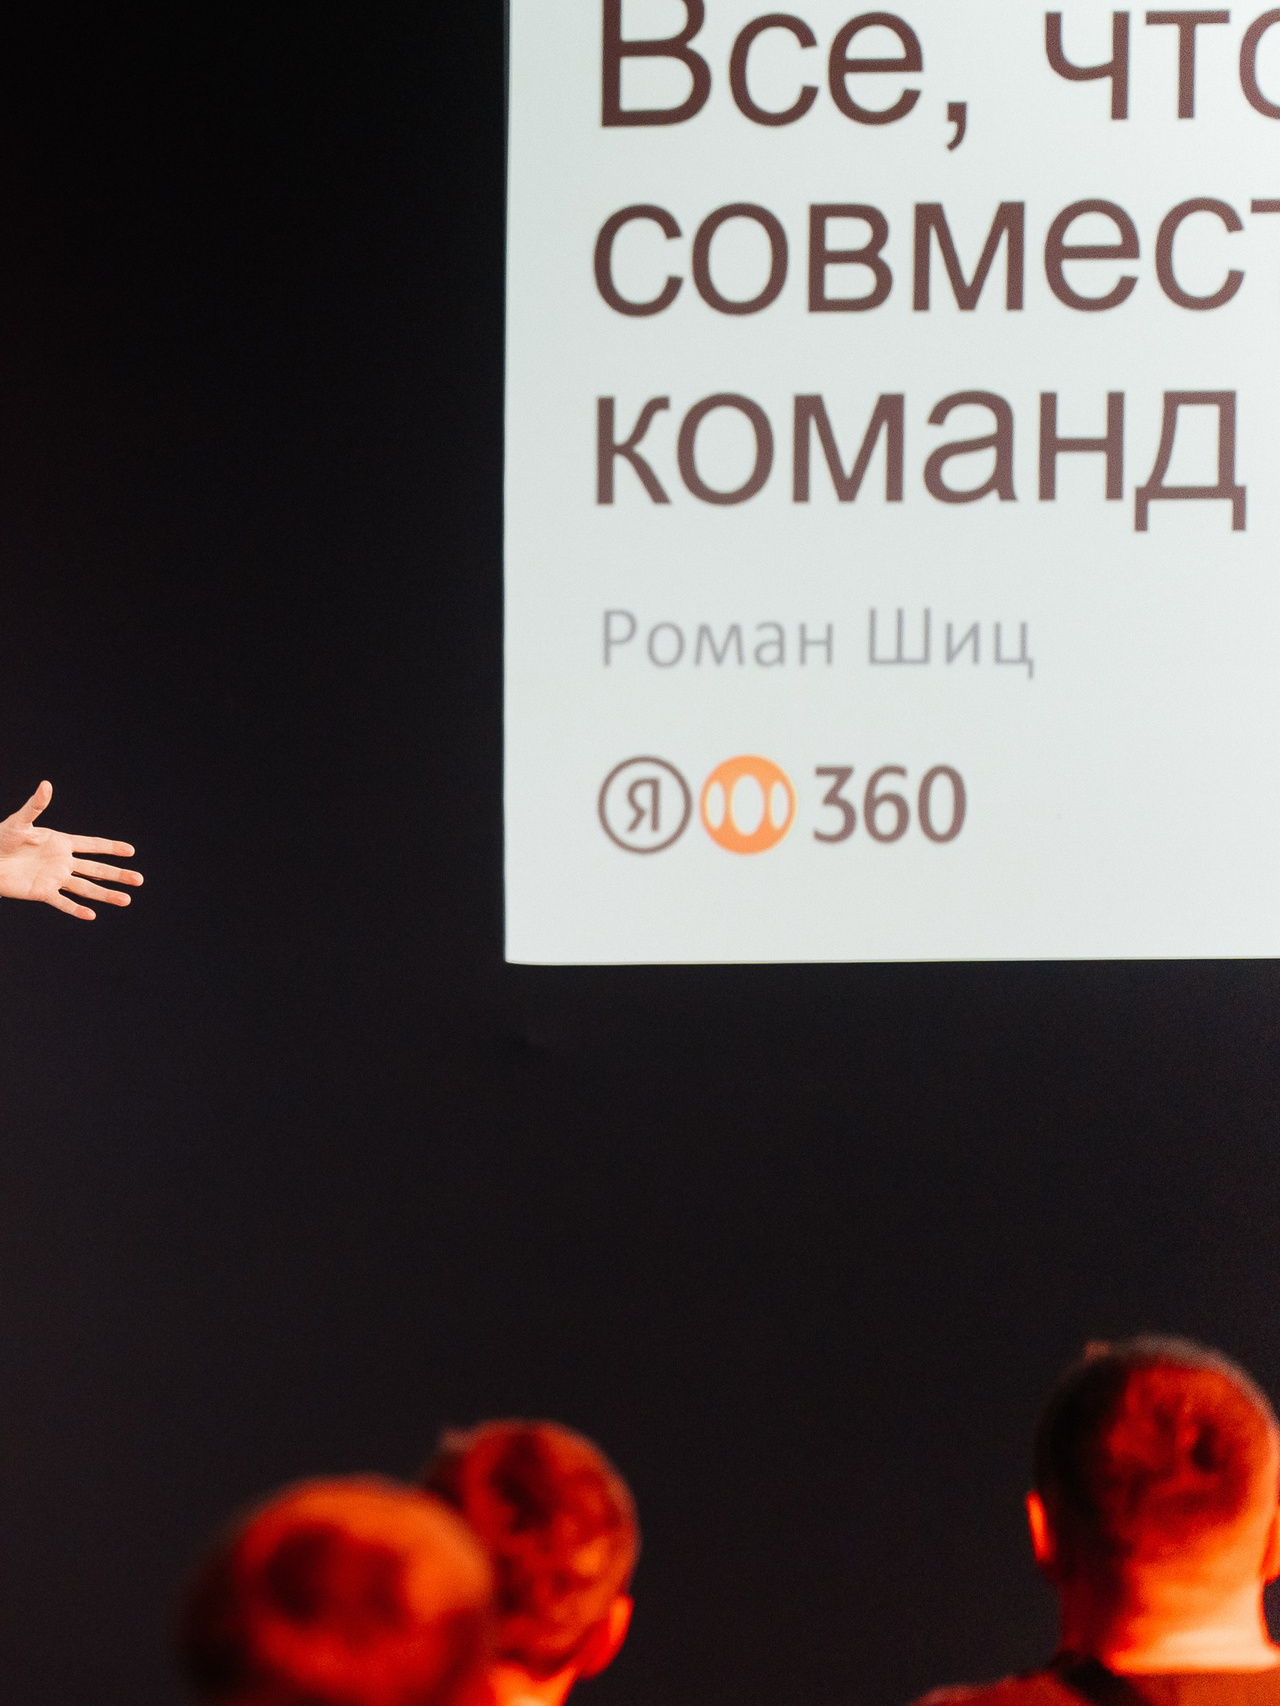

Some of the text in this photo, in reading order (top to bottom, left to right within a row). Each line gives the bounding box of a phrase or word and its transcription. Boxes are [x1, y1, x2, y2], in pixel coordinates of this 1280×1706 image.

[600, 0, 968, 152] Все,
[596, 389, 1247, 533] команд
[601, 607, 1036, 679] Роман Шиц
[813, 764, 967, 844] 360
